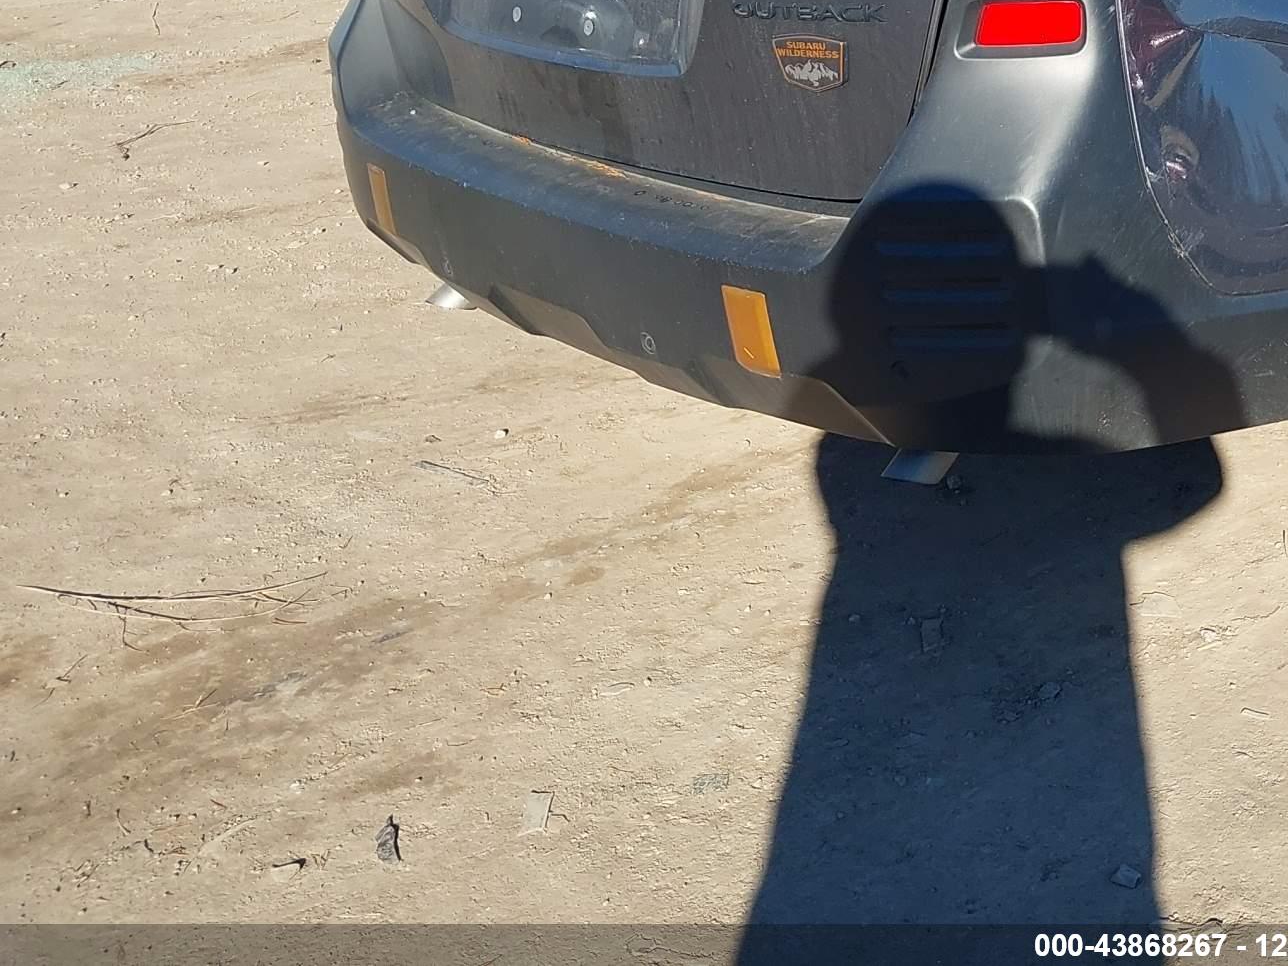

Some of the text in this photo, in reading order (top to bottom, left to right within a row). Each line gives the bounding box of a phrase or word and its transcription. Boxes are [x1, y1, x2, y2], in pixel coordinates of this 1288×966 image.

[732, 1, 888, 23] OUTBACK
[786, 40, 826, 50] SUBARU
[776, 48, 840, 59] WILDERNESS
